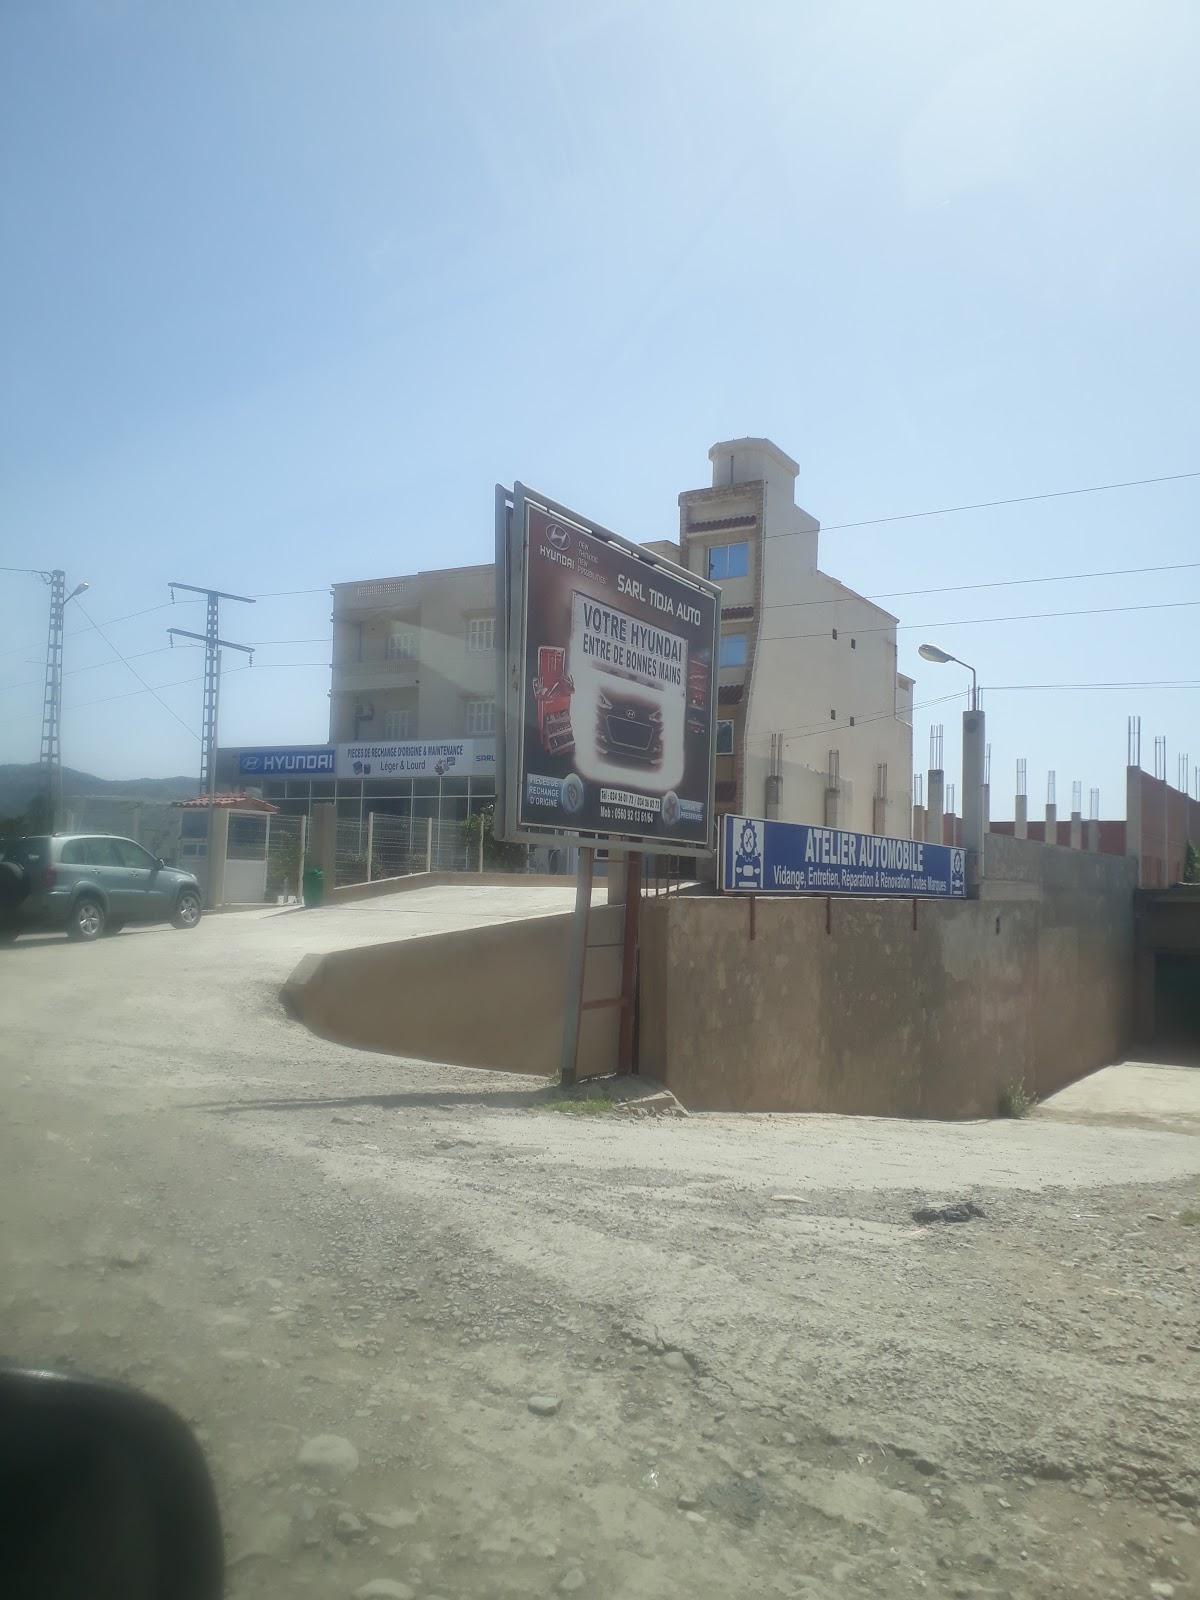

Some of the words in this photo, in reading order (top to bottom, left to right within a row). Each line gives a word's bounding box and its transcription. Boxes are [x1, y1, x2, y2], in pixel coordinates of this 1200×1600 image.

[539, 544, 575, 570] HYUNDAI
[617, 574, 646, 602] SARL
[649, 587, 674, 616] TIDJA
[676, 604, 701, 626] AUTO
[583, 602, 627, 642] VOTRE
[630, 622, 682, 662] HYUNDAI
[583, 632, 610, 661] ENTRE
[613, 644, 624, 666] DE
[626, 649, 657, 677] BONNES
[658, 661, 681, 686] MAINS
[364, 748, 371, 758] DE
[371, 747, 398, 758] RECHANGE
[427, 745, 463, 757] MAINTENANCE
[264, 755, 332, 770] HYUNDAI
[380, 760, 399, 773] Léger
[400, 760, 405, 770] &
[406, 760, 426, 770] Lourd
[528, 786, 560, 798] RECHANGE
[529, 796, 559, 808] D'ORIGINE
[600, 806, 611, 818] Mob
[804, 828, 856, 866] ATELIER
[859, 836, 923, 872] AUTOMOBILE
[773, 864, 807, 889] Vidange,
[808, 866, 840, 888] Entretien,
[841, 869, 874, 890] Réparation
[874, 872, 879, 887] &
[880, 871, 911, 889] Rénovation
[911, 874, 927, 891] Toutes
[927, 876, 947, 894] Marques
